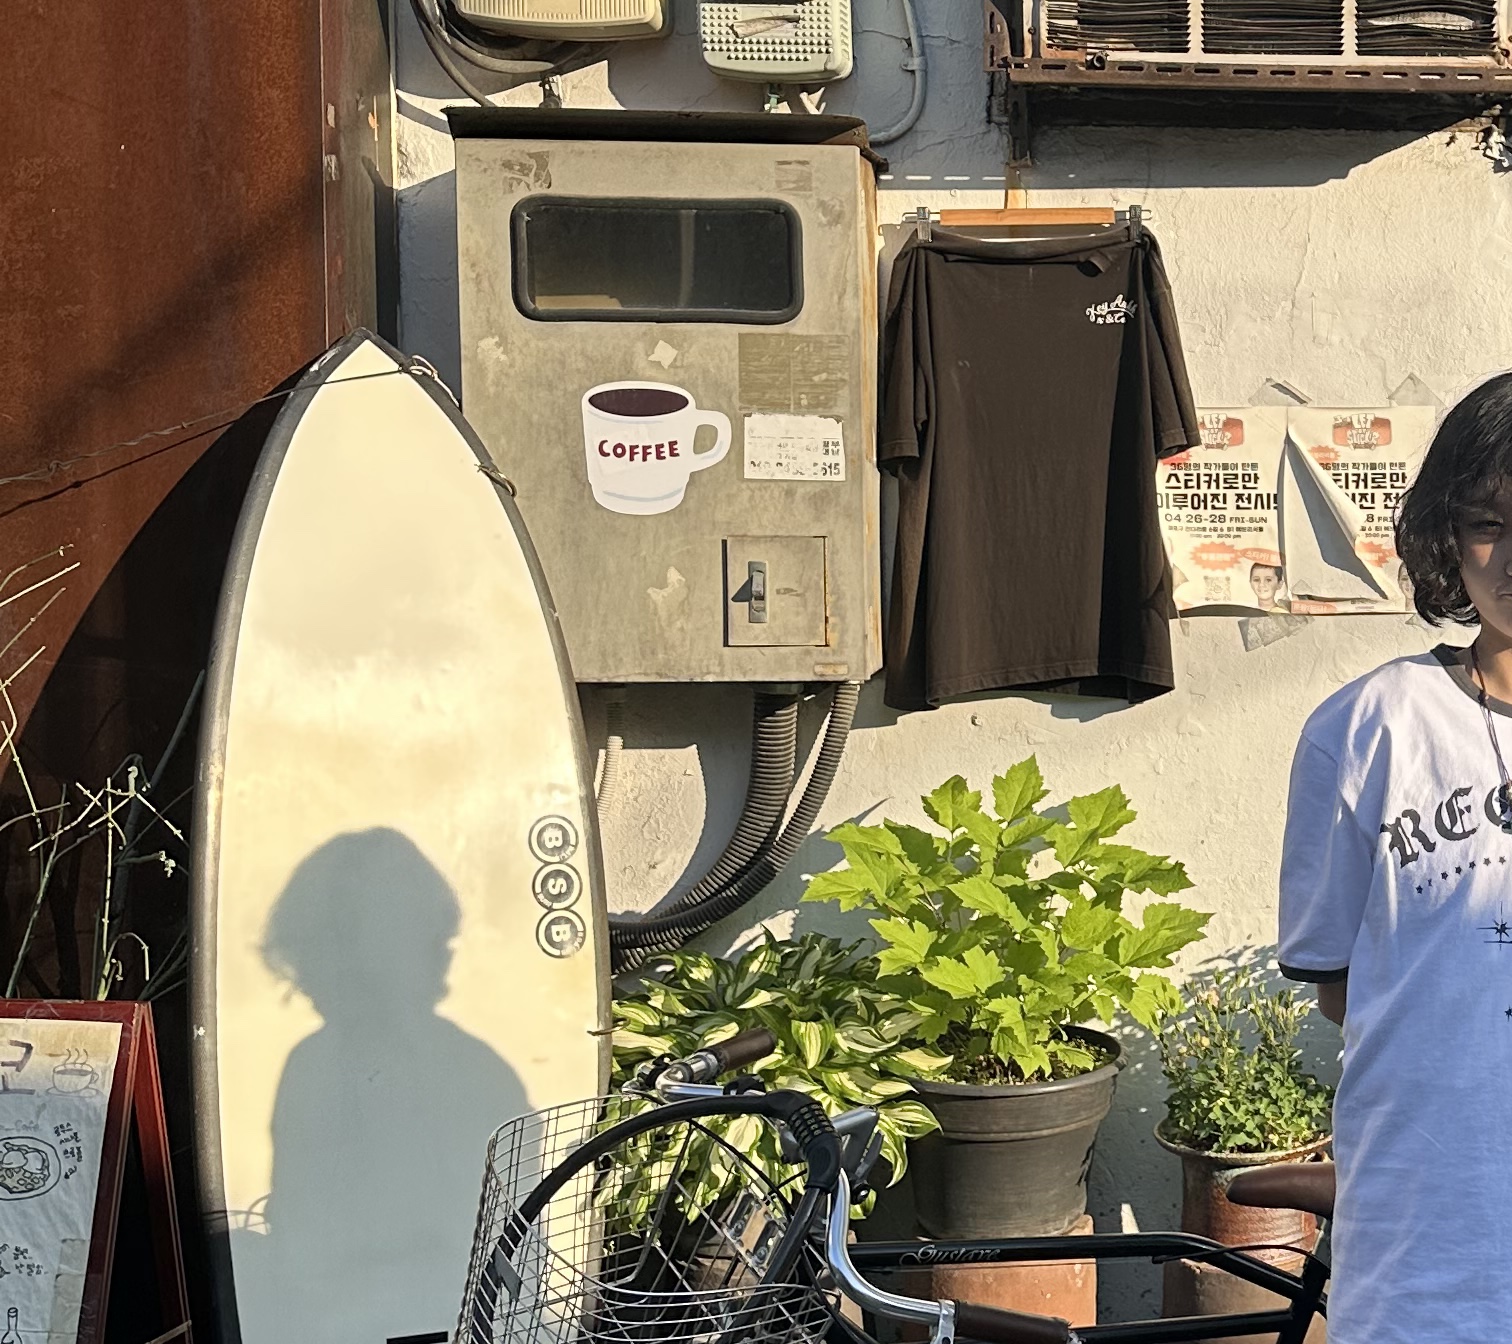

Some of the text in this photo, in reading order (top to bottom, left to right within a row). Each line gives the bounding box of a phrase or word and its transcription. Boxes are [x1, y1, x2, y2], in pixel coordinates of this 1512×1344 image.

[598, 439, 680, 462] COFFEE
[1164, 472, 1260, 490] 스티커로만
[1331, 472, 1408, 490] 티커로만
[1157, 492, 1228, 511] 이루어진
[1164, 513, 1182, 523] 04
[1185, 513, 1227, 524] 26-28
[899, 1244, 1001, 1265] Gustave
